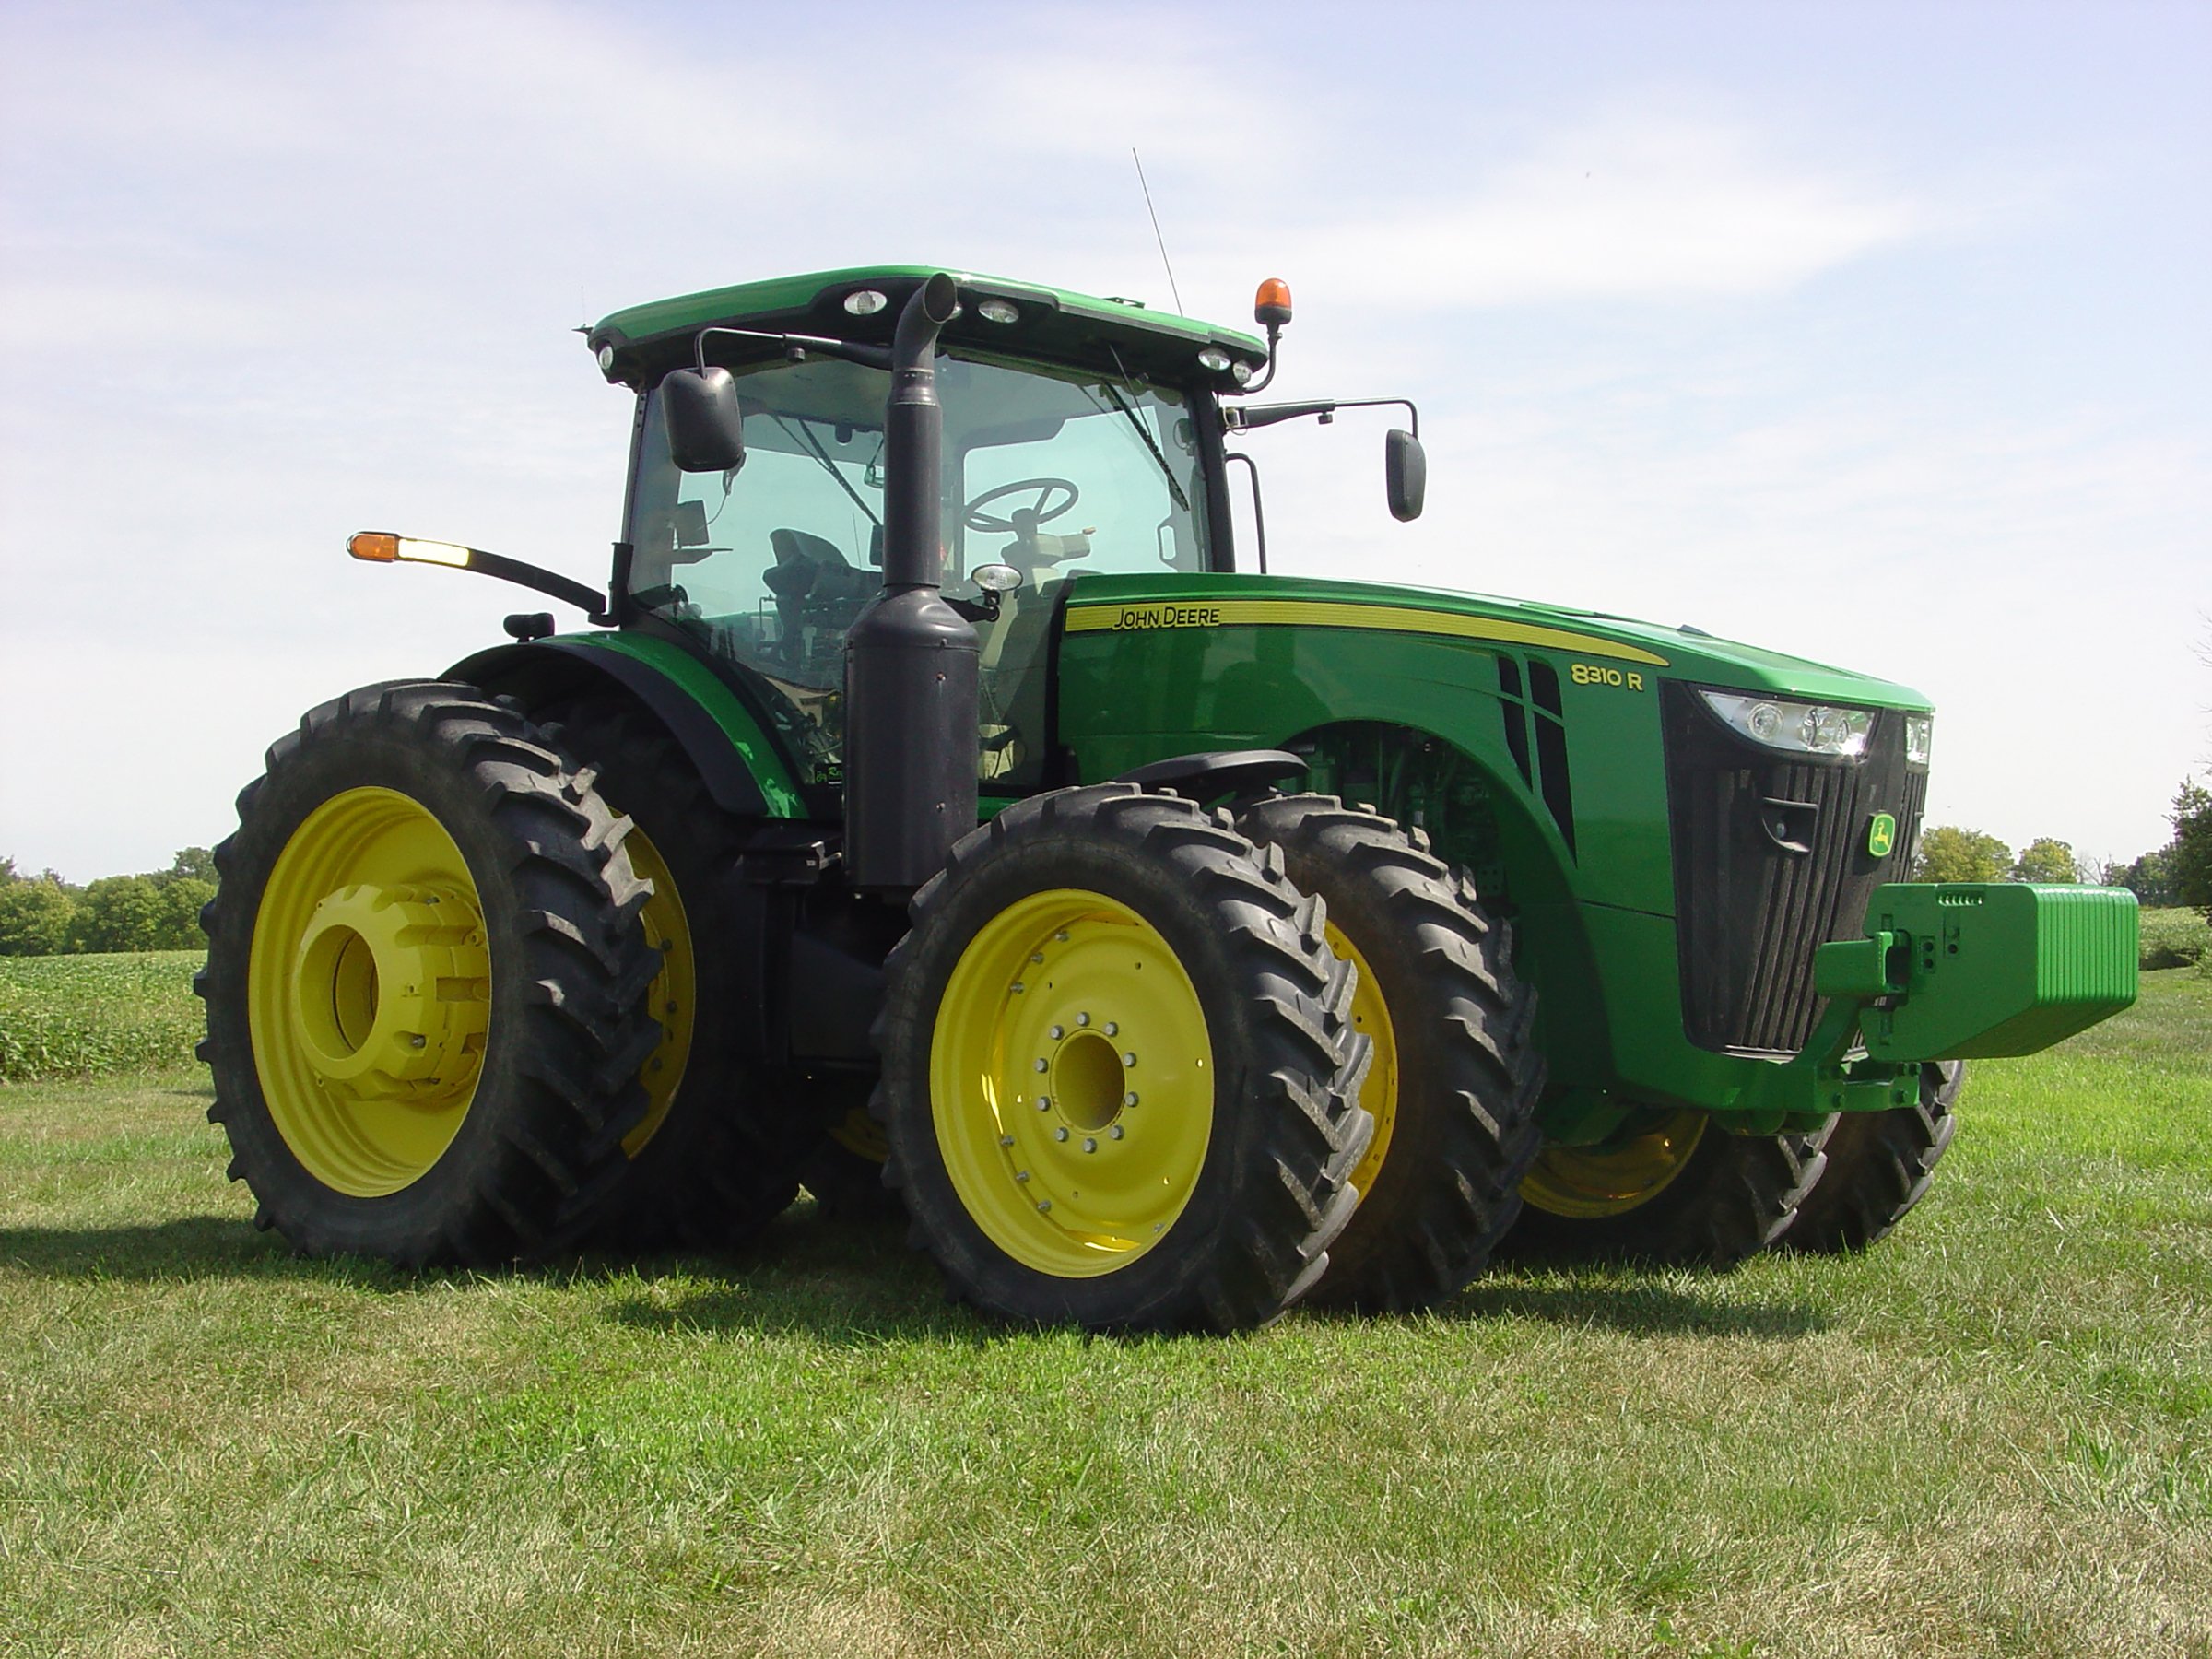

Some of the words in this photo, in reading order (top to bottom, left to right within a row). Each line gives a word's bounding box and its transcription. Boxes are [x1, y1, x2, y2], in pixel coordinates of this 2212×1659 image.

[1113, 608, 1160, 629] JOHN
[1163, 606, 1221, 626] DEERE
[1571, 663, 1622, 687] 8310
[1626, 671, 1644, 692] R
